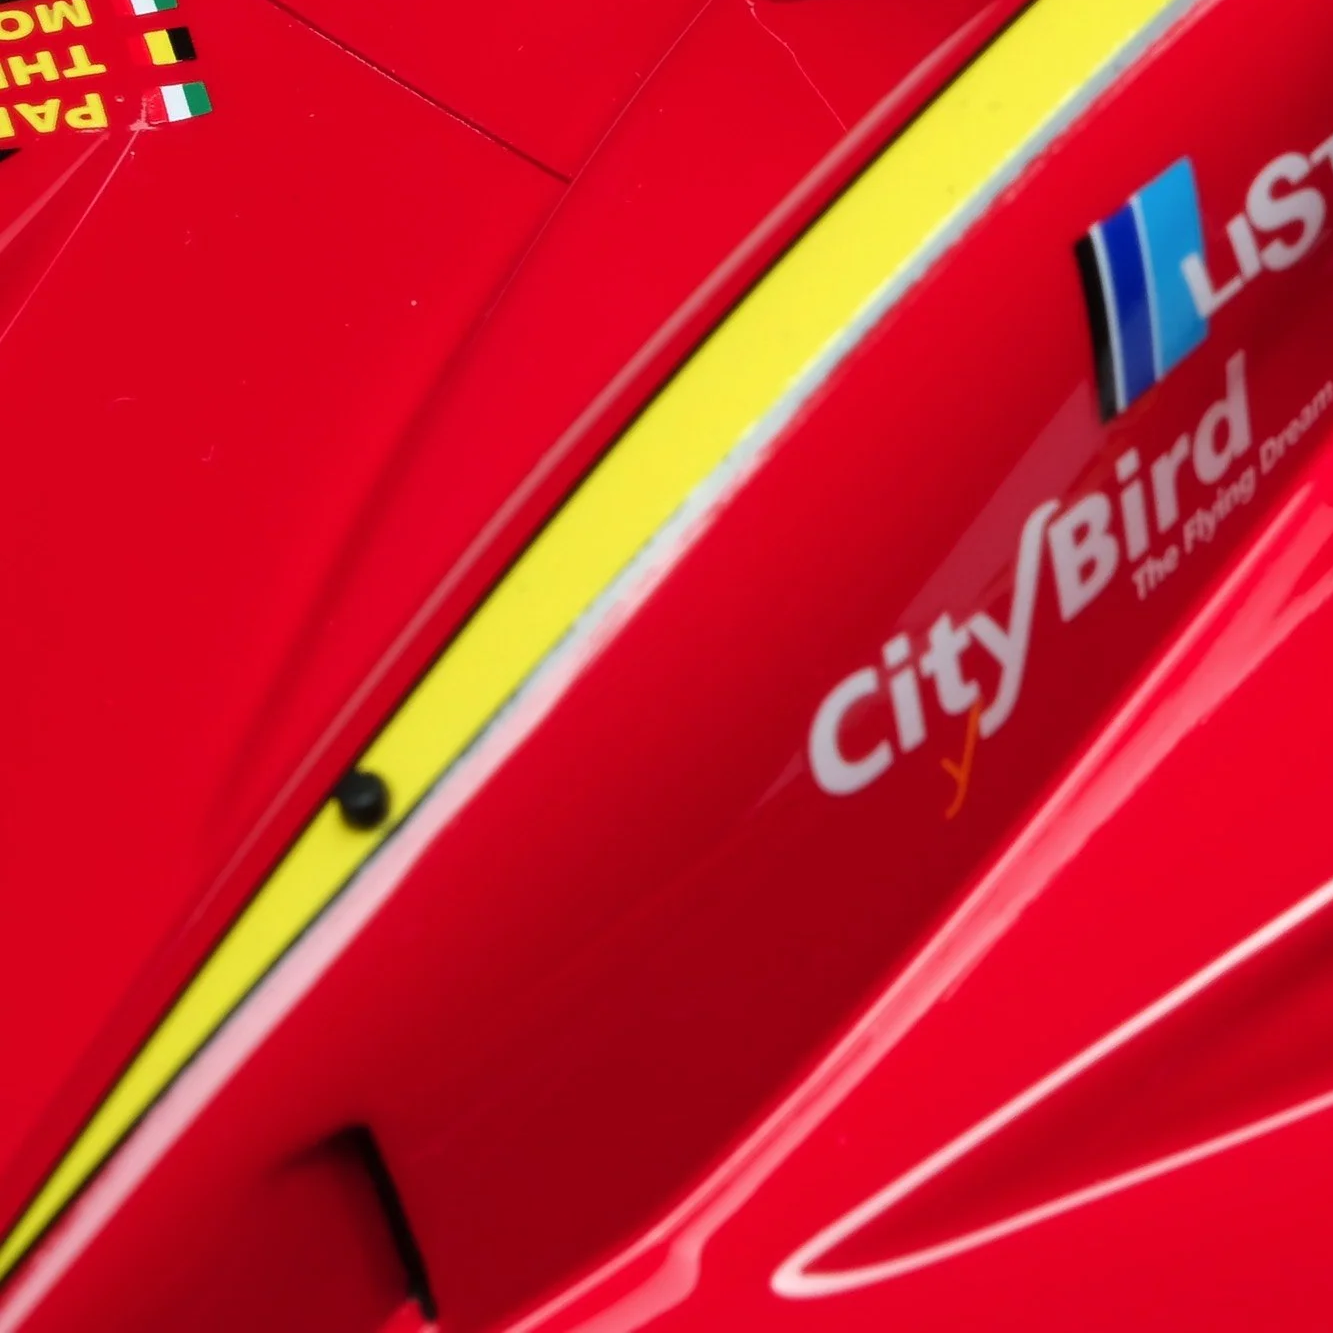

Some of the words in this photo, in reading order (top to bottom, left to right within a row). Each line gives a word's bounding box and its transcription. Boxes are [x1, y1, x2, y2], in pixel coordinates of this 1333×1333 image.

[0, 45, 107, 89] TH
[1131, 544, 1180, 601] The
[1183, 464, 1257, 555] Flying
